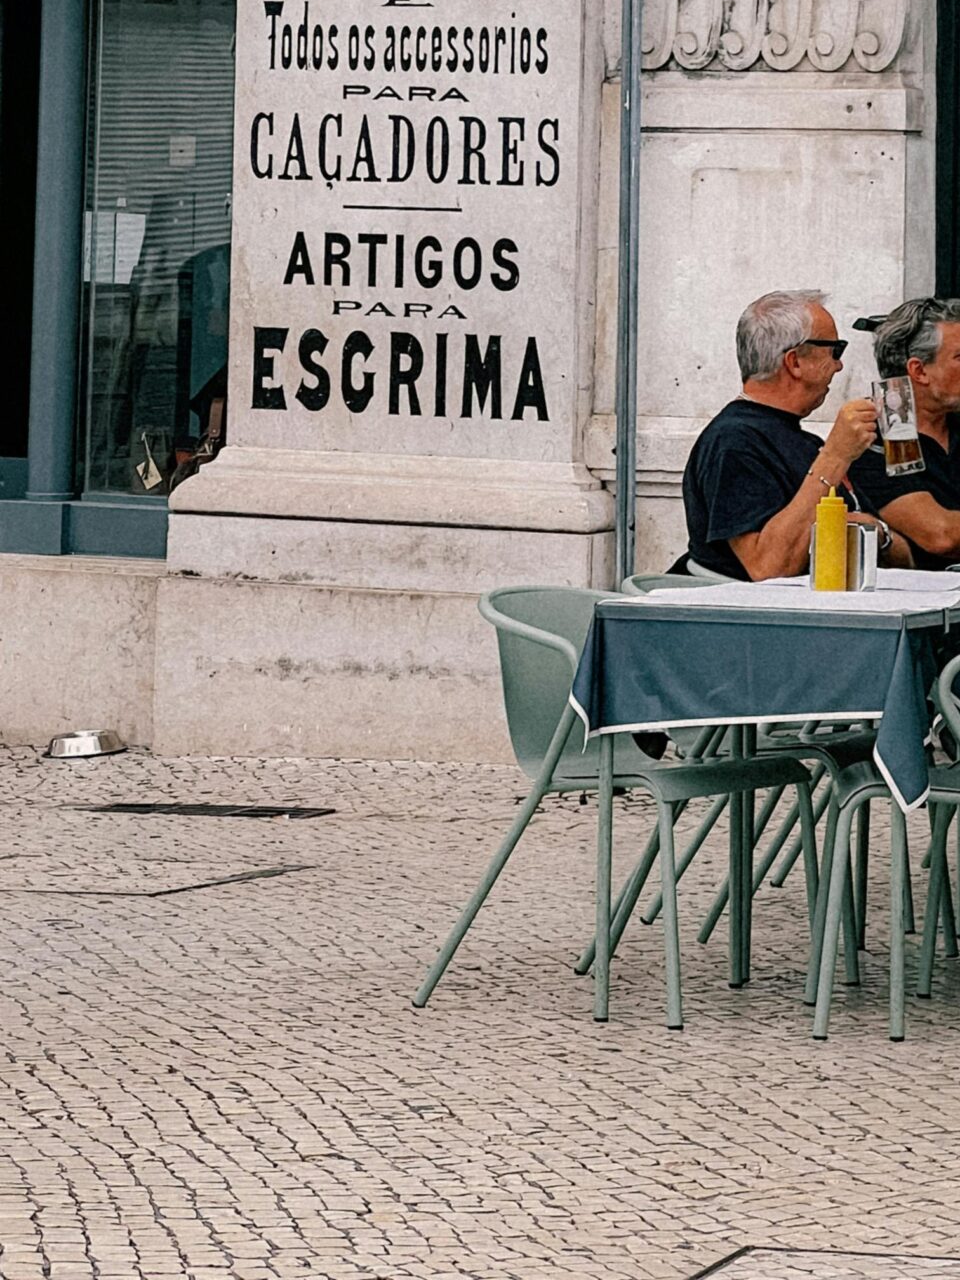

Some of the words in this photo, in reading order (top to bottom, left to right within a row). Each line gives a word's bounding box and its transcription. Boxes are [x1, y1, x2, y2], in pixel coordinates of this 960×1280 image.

[264, 1, 338, 70] Todos
[349, 24, 376, 72] os
[384, 12, 549, 74] accessorios
[343, 84, 470, 102] PARA
[250, 112, 560, 189] CAÇADORES
[283, 231, 520, 291] ARTIGOS
[332, 300, 467, 320] PARA
[250, 326, 550, 421] ESGRIMA
